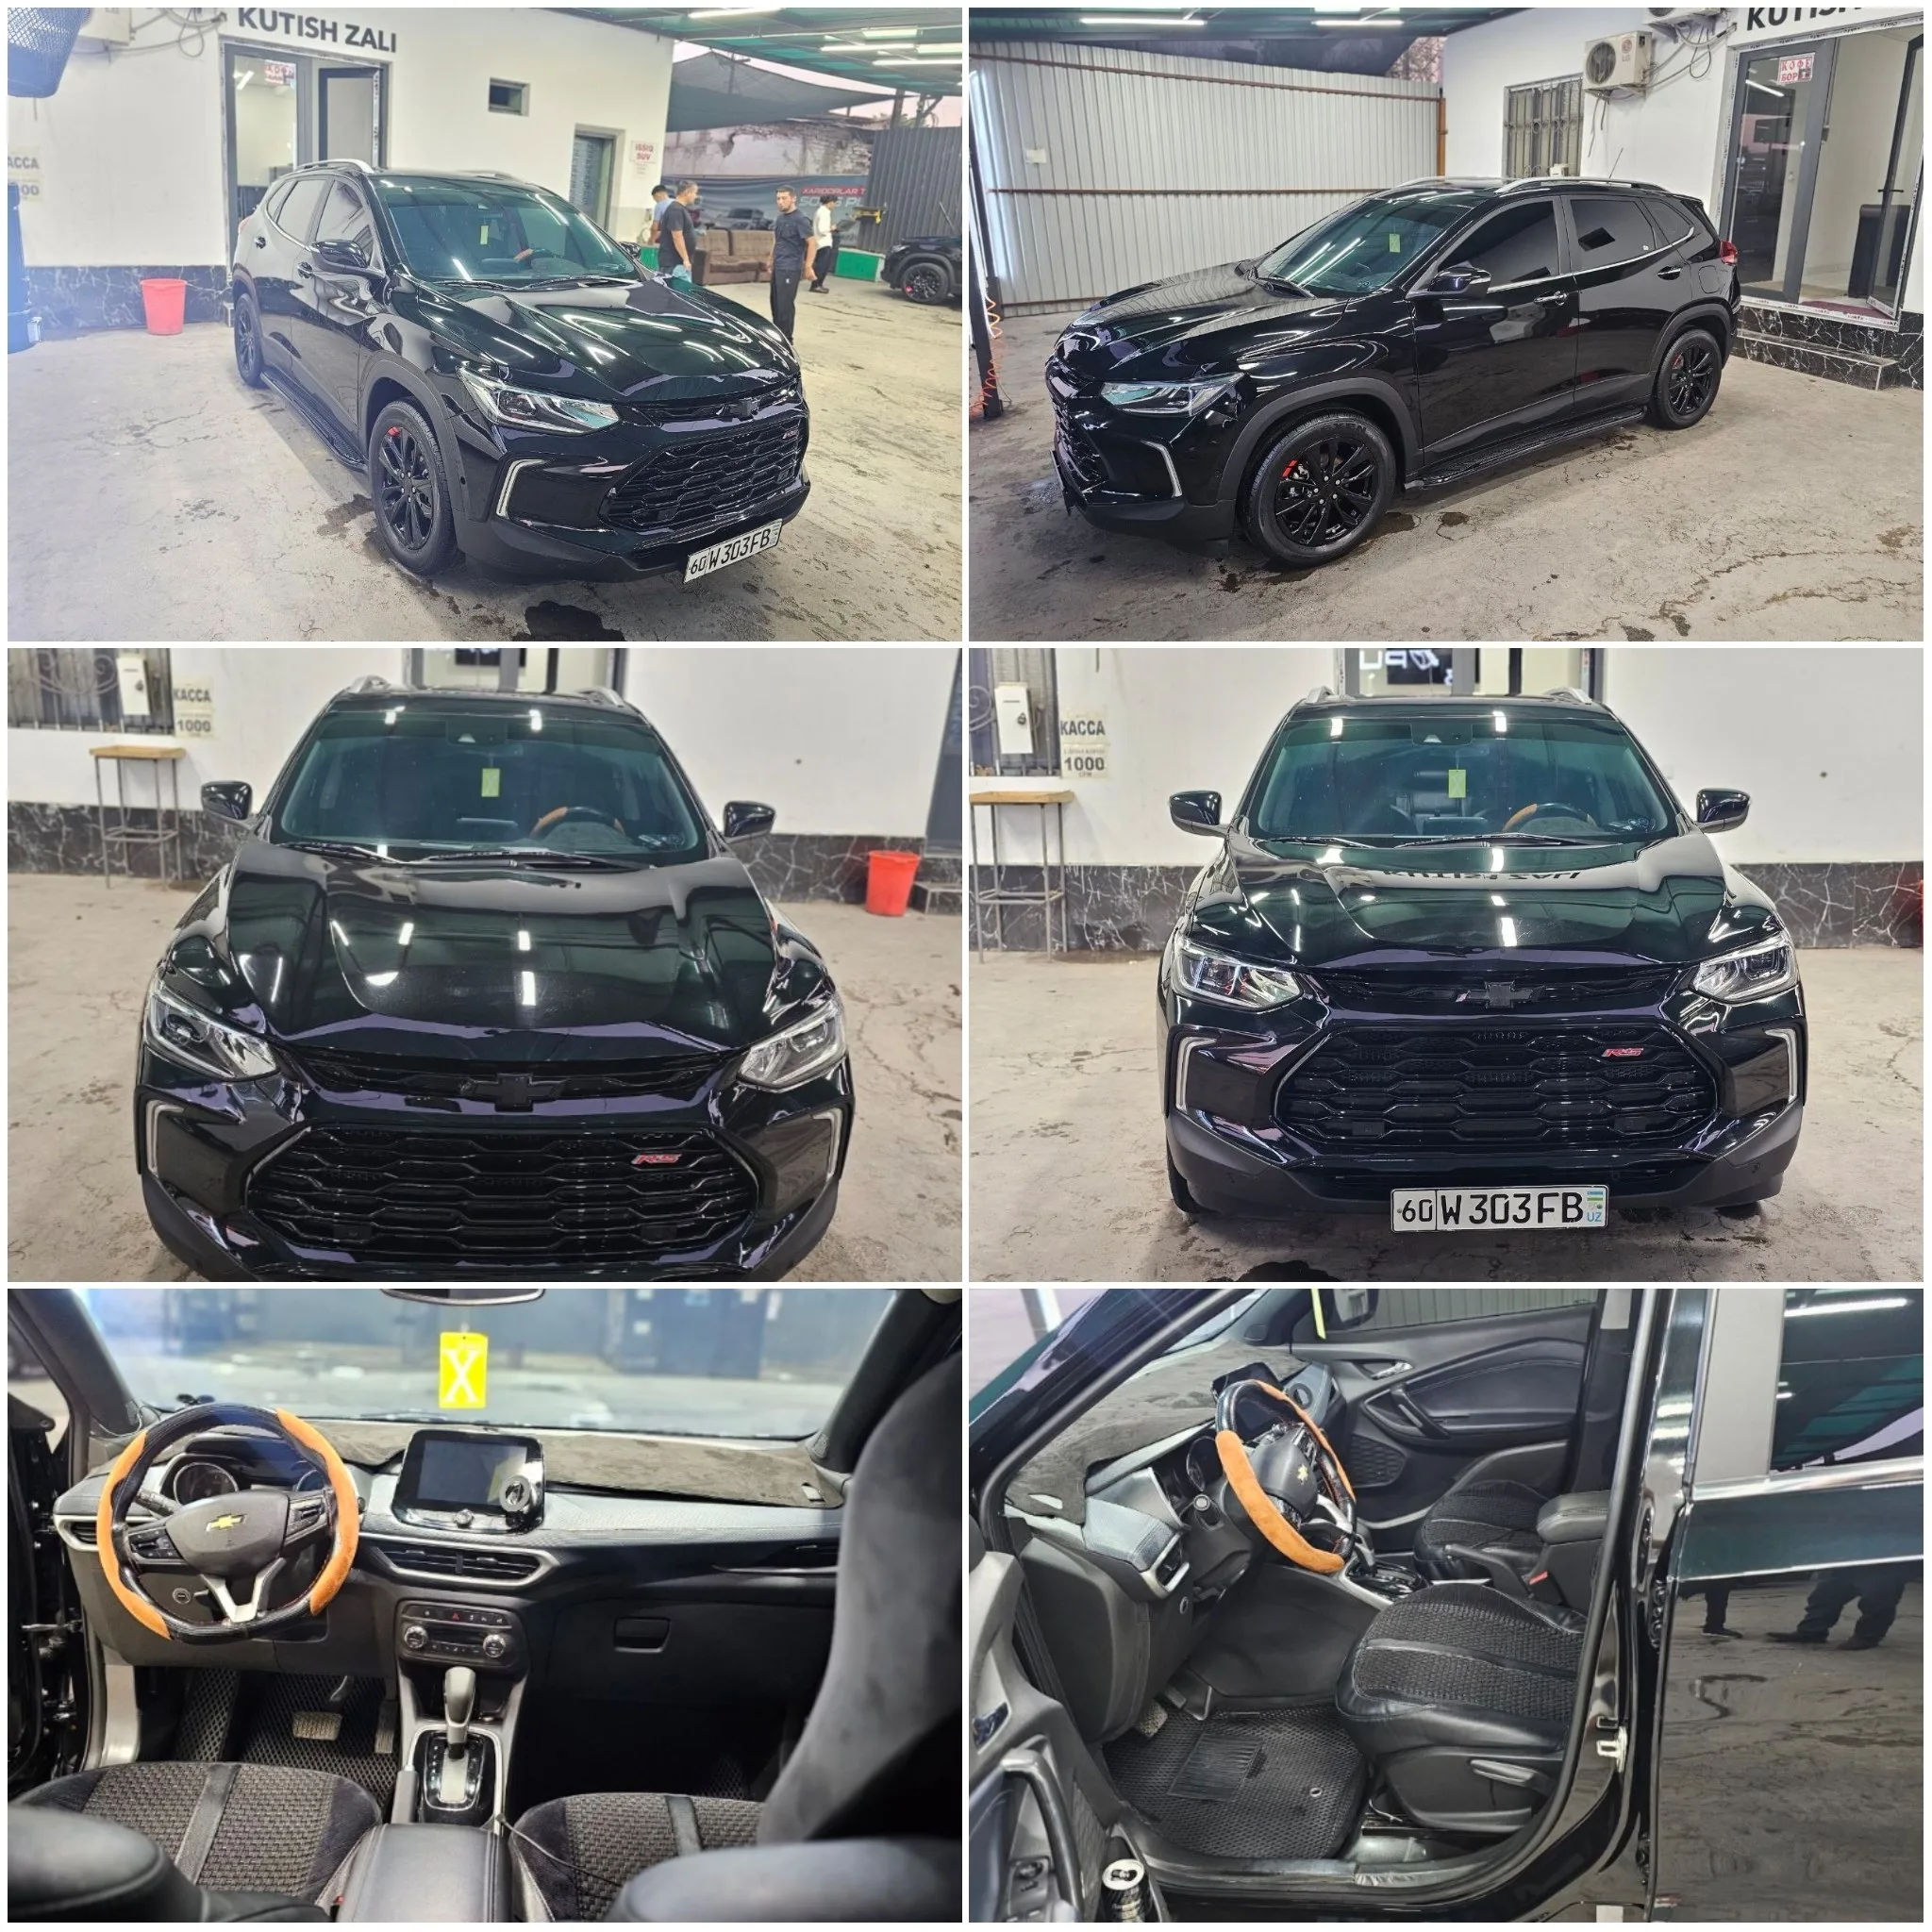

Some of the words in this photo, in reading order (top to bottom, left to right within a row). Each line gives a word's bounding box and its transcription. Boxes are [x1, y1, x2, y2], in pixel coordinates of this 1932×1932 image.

[238, 8, 338, 42] KUTISH
[345, 24, 396, 53] ZALI
[177, 720, 211, 733] 1000
[1060, 720, 1106, 736] КАССА
[1064, 757, 1105, 772] 1000
[1587, 1211, 1603, 1224] UZ
